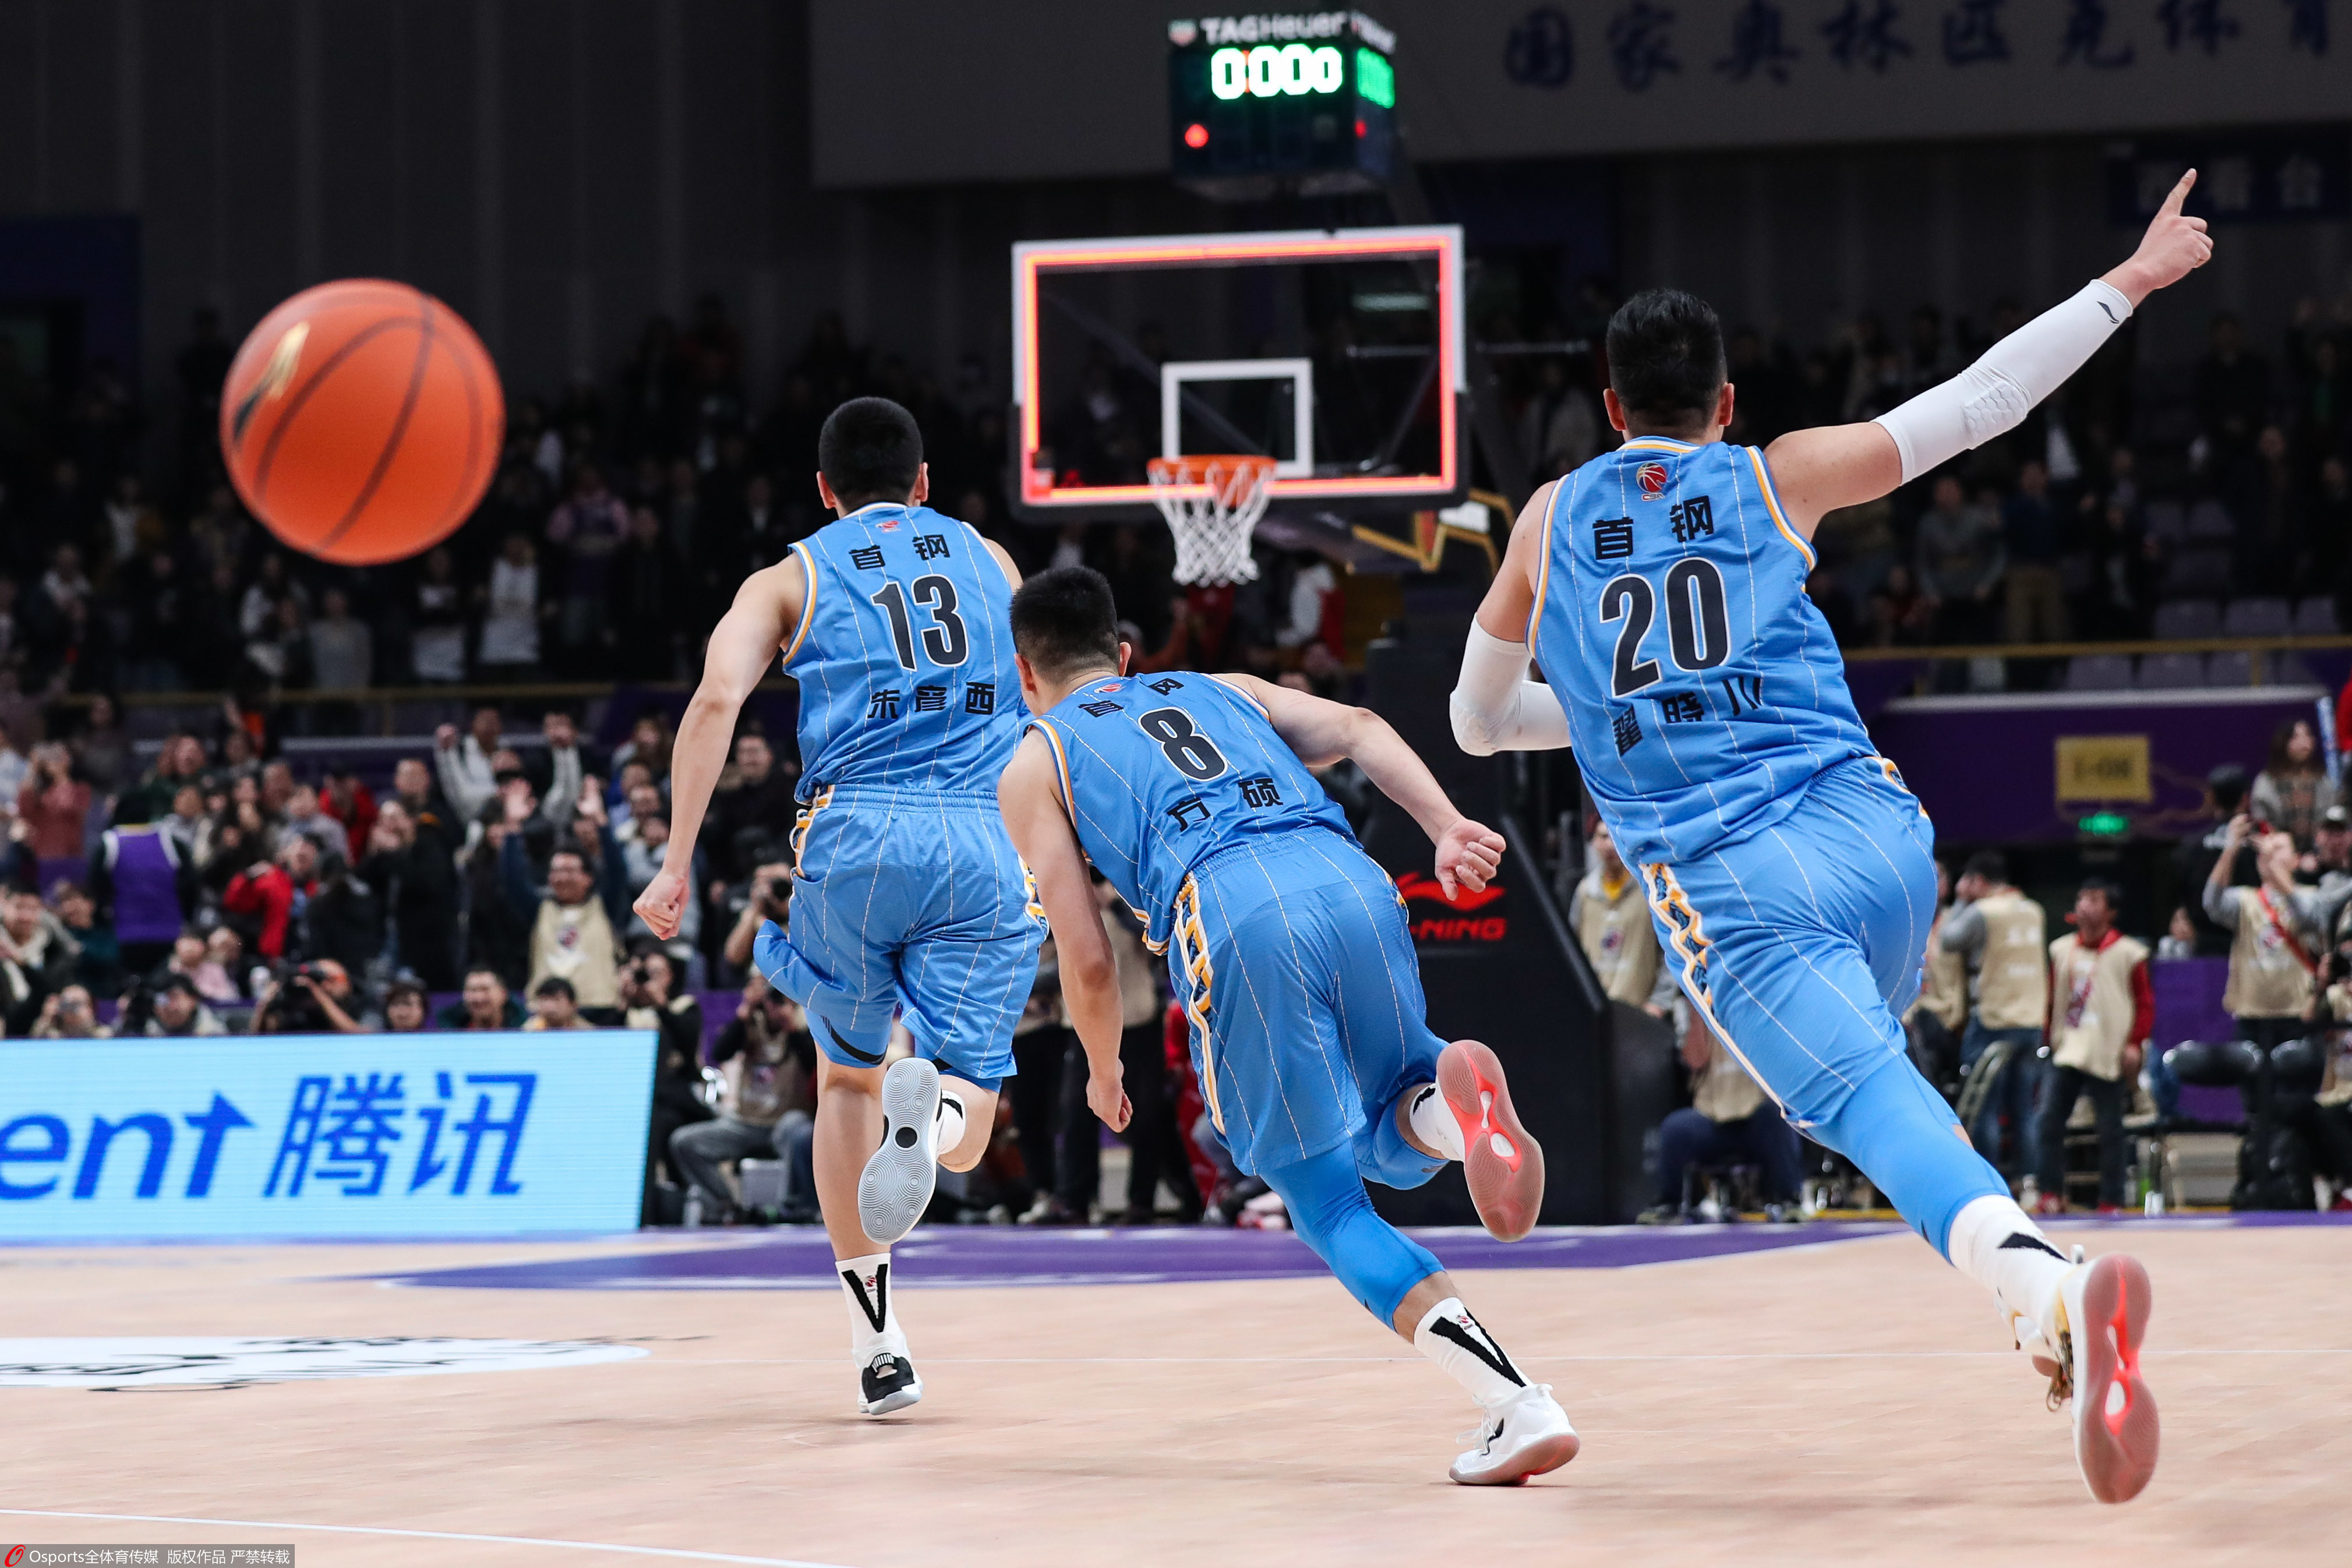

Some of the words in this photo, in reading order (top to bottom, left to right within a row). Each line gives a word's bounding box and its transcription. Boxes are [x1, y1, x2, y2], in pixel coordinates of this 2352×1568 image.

[849, 534, 951, 570] 首钢
[1592, 495, 1714, 560] 首钢
[870, 574, 970, 672] 13
[1598, 557, 1732, 698] 20
[867, 681, 996, 719] 朱彦西
[1138, 706, 1228, 782] 8
[1167, 778, 1283, 831] 方硕
[263, 1071, 538, 1196] 腾讯
